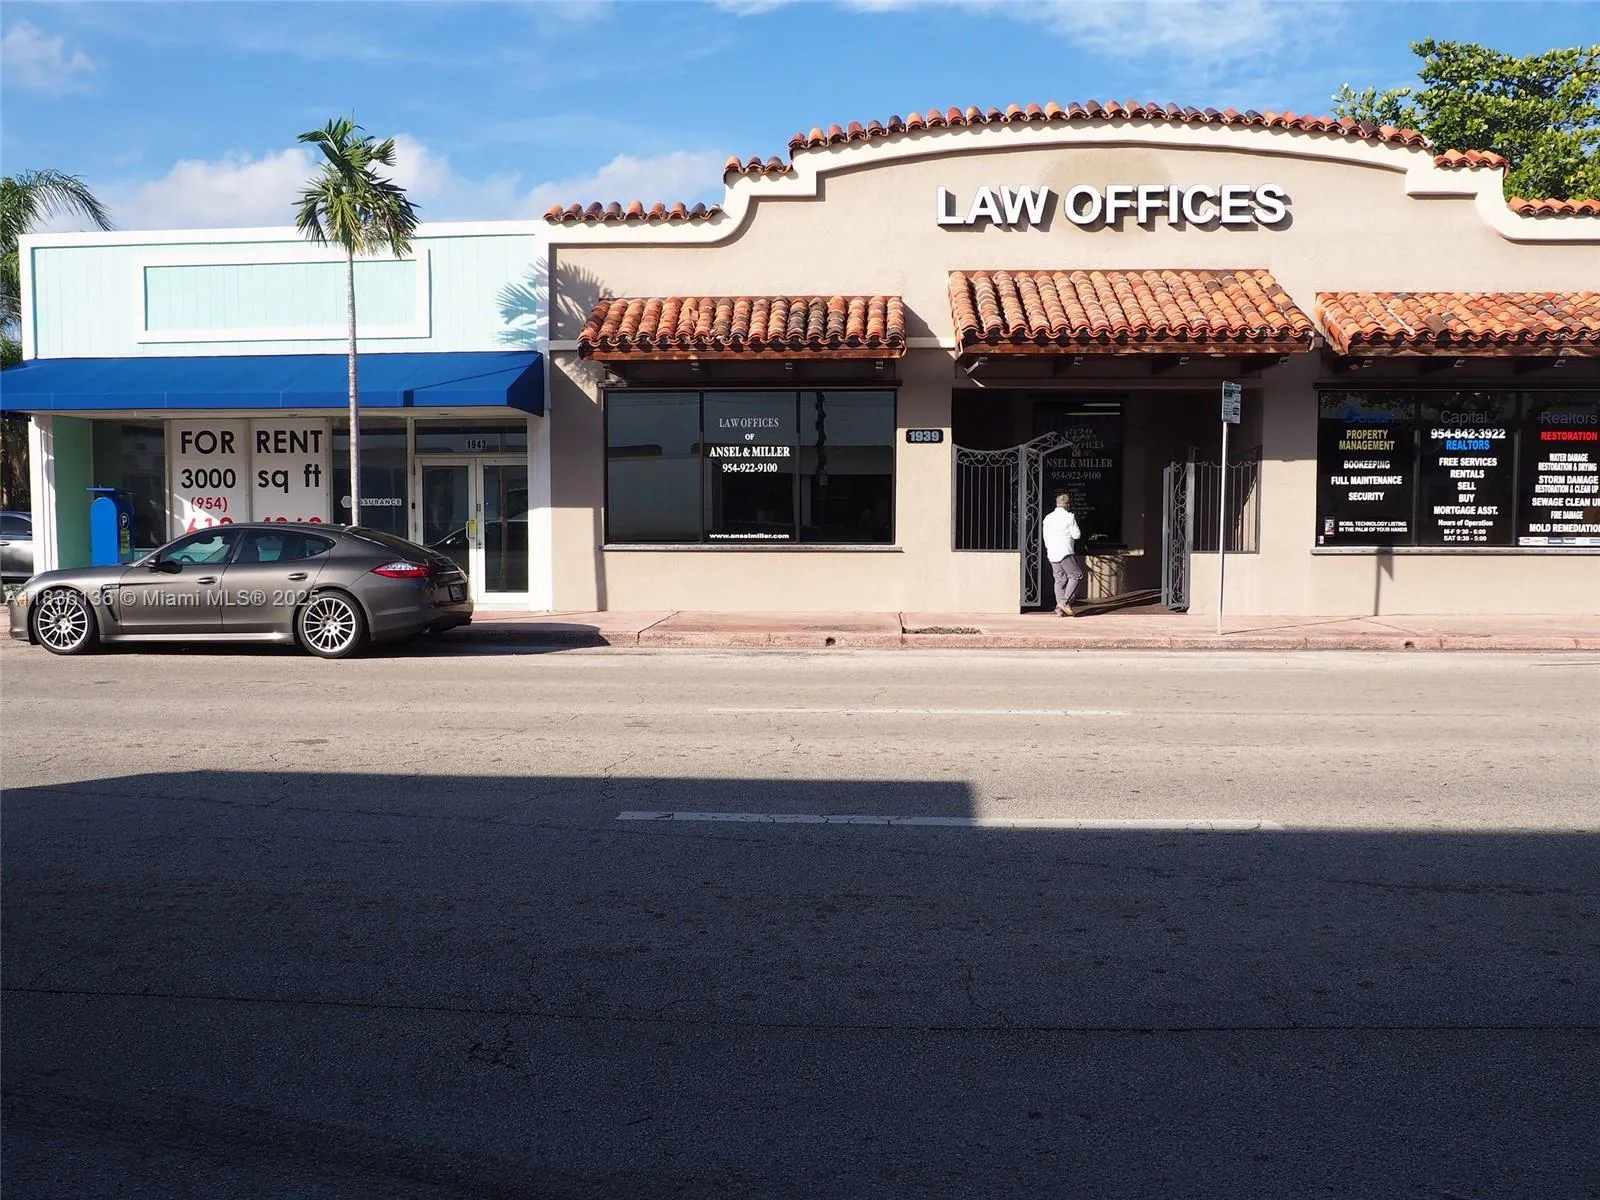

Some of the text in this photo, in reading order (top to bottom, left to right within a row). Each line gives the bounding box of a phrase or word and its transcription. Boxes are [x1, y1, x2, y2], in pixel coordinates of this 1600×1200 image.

[937, 183, 1287, 225] LAW OFFICES
[719, 417, 779, 428] LAW OFFICES
[1440, 410, 1488, 426] Capital
[1540, 411, 1598, 424] Realtors
[744, 433, 755, 441] OF
[908, 430, 940, 442] 1939
[1346, 429, 1389, 440] PROPERTY
[1430, 428, 1506, 439] 954-842-3922
[1541, 431, 1598, 441] RESTORATION
[181, 430, 323, 454] FOR RENT
[466, 439, 487, 449] 1943
[1339, 440, 1395, 450] MANAGEMENT
[1446, 440, 1490, 450] REALTORS
[709, 446, 790, 457] ANSEL & MILLER
[1439, 457, 1498, 466] FREE SERVICES
[1549, 453, 1589, 462] WATER DAMAGE
[722, 462, 778, 473] 954-922-9100
[1046, 458, 1069, 468] NSEL
[1079, 458, 1113, 468] MILLER
[1343, 460, 1391, 469] BOOKEEPING
[1538, 462, 1573, 472] RESTORATION
[181, 463, 321, 494] 3000 sq ft
[1450, 469, 1485, 479] RENTALS
[1330, 475, 1403, 485] FULL MAINTENANCE
[1538, 475, 1599, 484] STORM DAMAGE
[1457, 481, 1477, 491] SELL
[1535, 484, 1569, 493] RESTORATION
[1574, 484, 1591, 493] CLEAN
[1591, 484, 1599, 493] UP
[1348, 491, 1385, 501] SECURITY
[1458, 493, 1475, 503] BUY
[190, 496, 228, 513] (954)
[1531, 497, 1564, 507] SEWAGE
[1565, 497, 1590, 507] CLEAN
[1433, 505, 1499, 515] MORTGAGE ASST.
[1550, 510, 1584, 520] FIRE DAMAGE
[1464, 519, 1494, 527] Operation
[1529, 523, 1551, 533] MOLD
[709, 532, 790, 540] www.anselmiller.com
